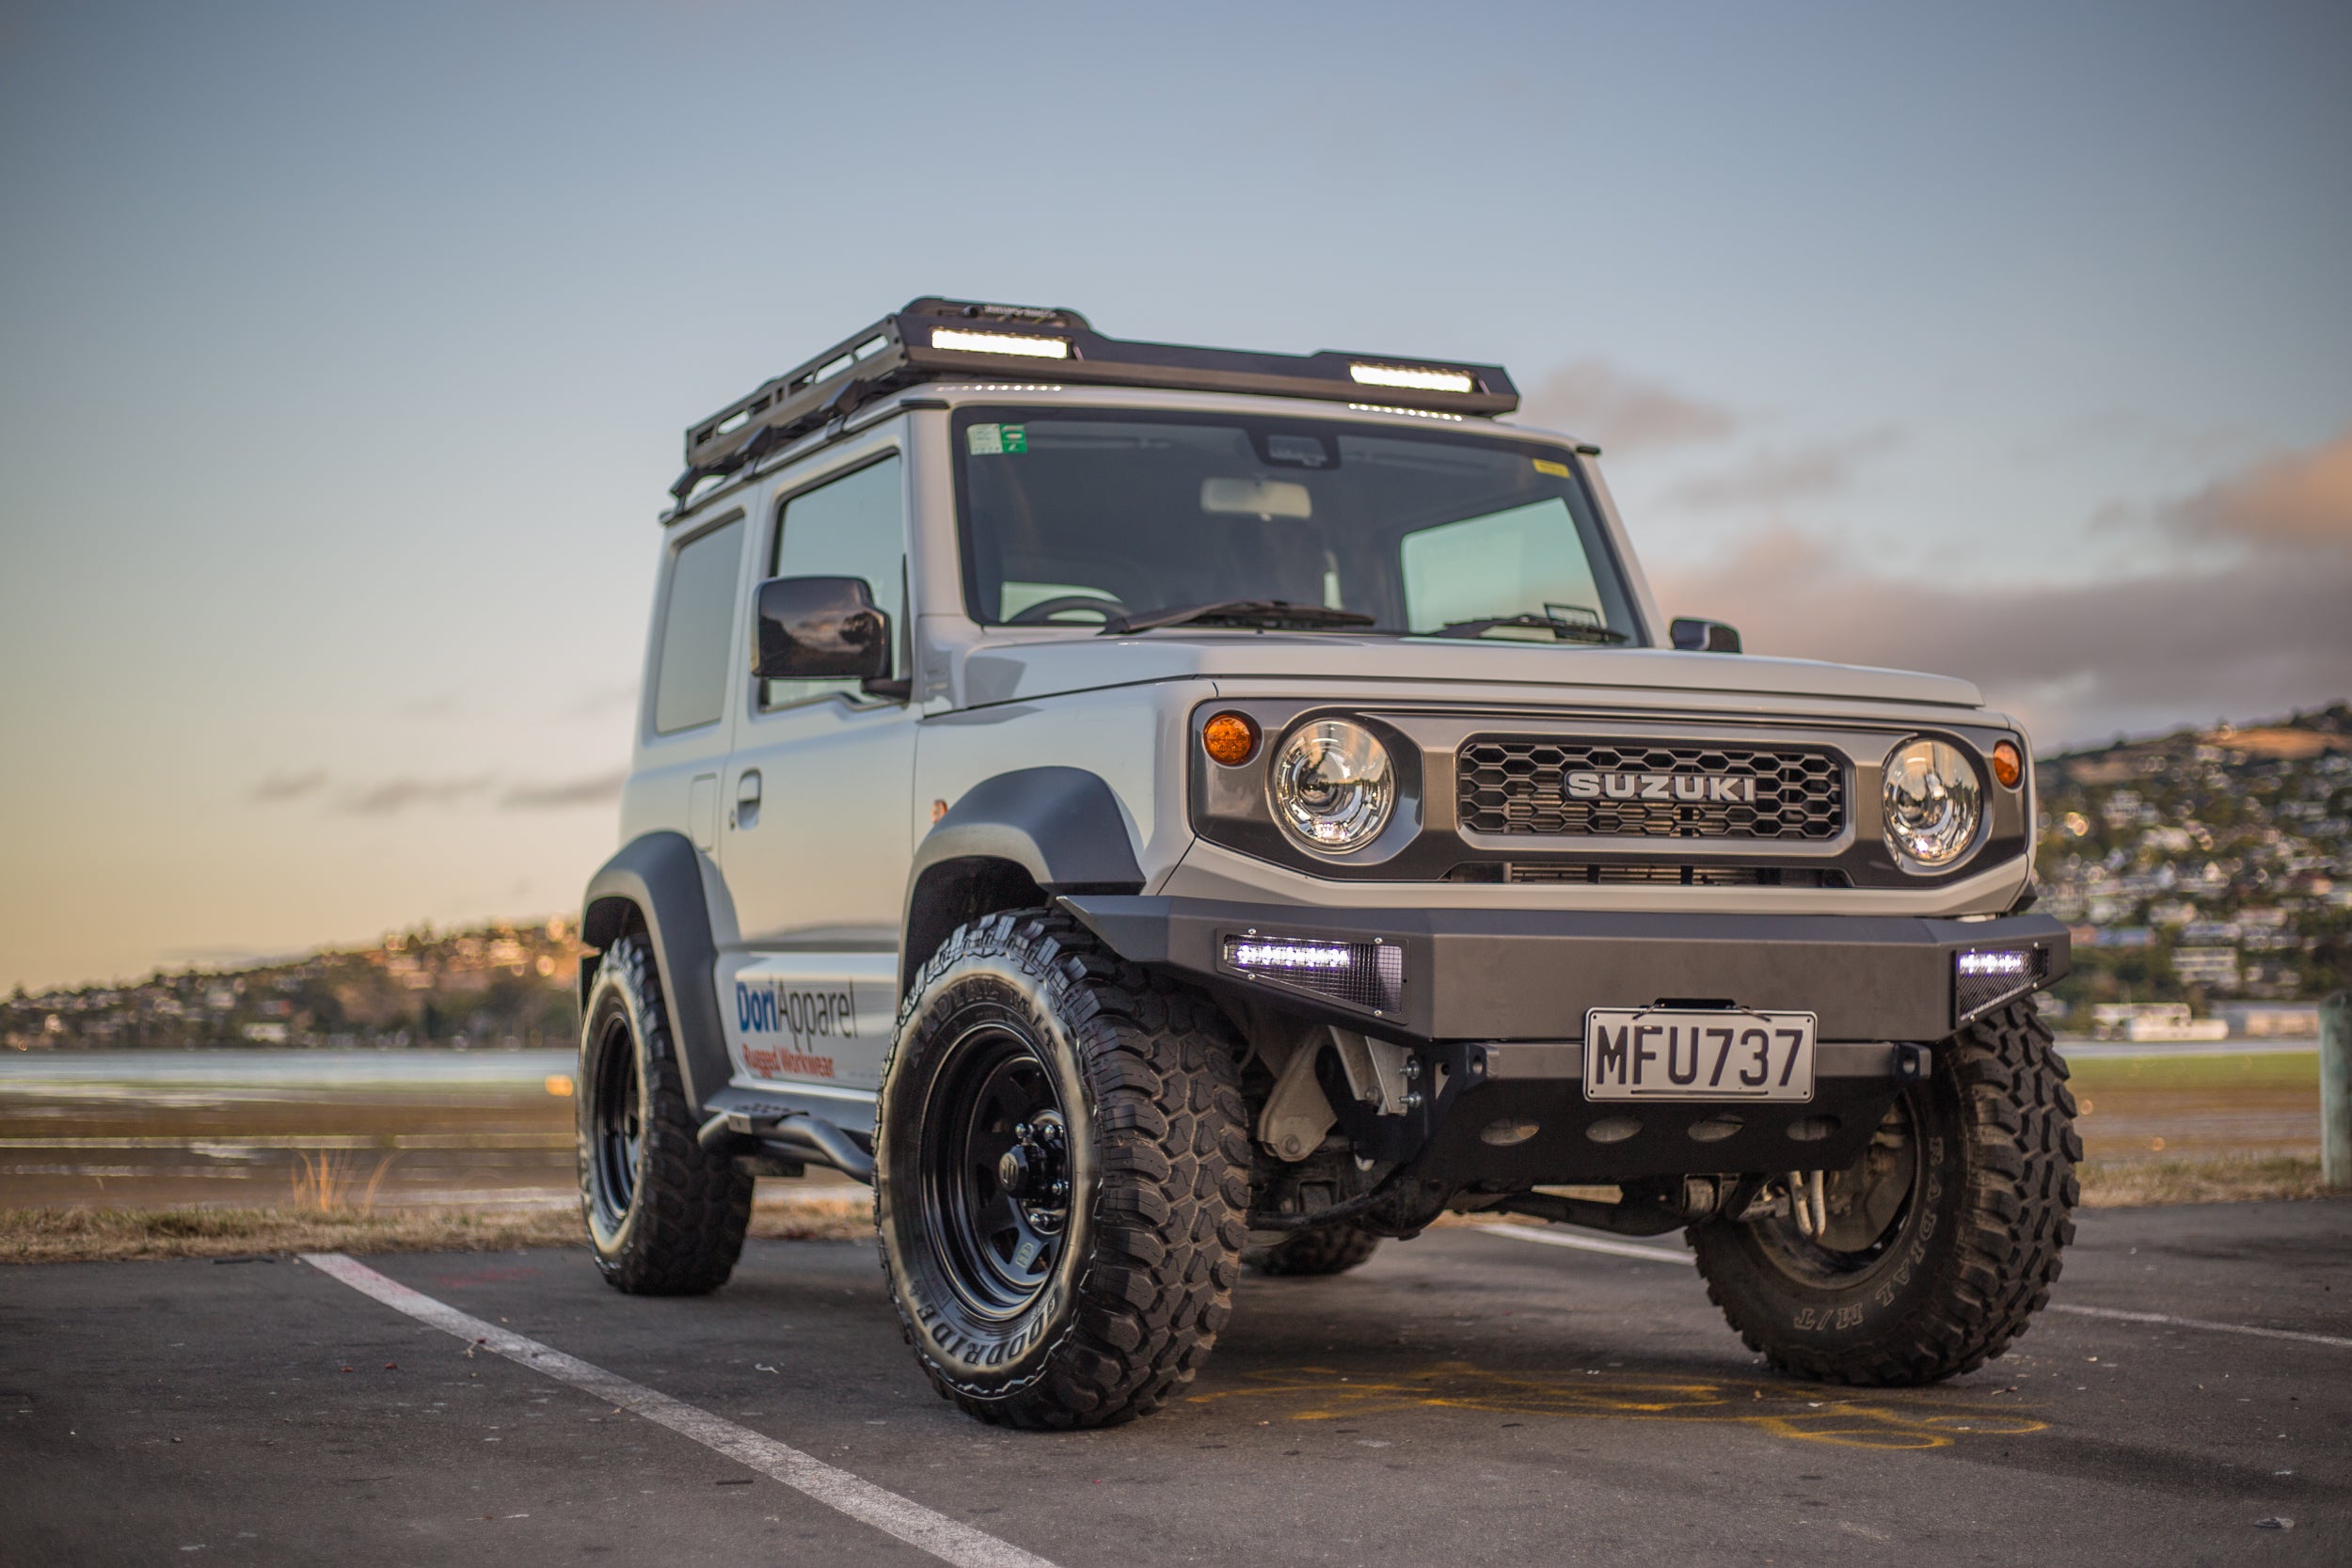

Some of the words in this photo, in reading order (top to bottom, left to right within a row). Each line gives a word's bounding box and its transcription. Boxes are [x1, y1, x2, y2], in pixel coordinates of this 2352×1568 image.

[1566, 771, 1755, 802] SUZUKI
[741, 1042, 782, 1079] Rugged
[1596, 1024, 1804, 1087] MFU737
[1875, 1135, 1945, 1307] RADIAL
[915, 1286, 1061, 1368] GOODRIDE
[1793, 1303, 1866, 1331] M/T
